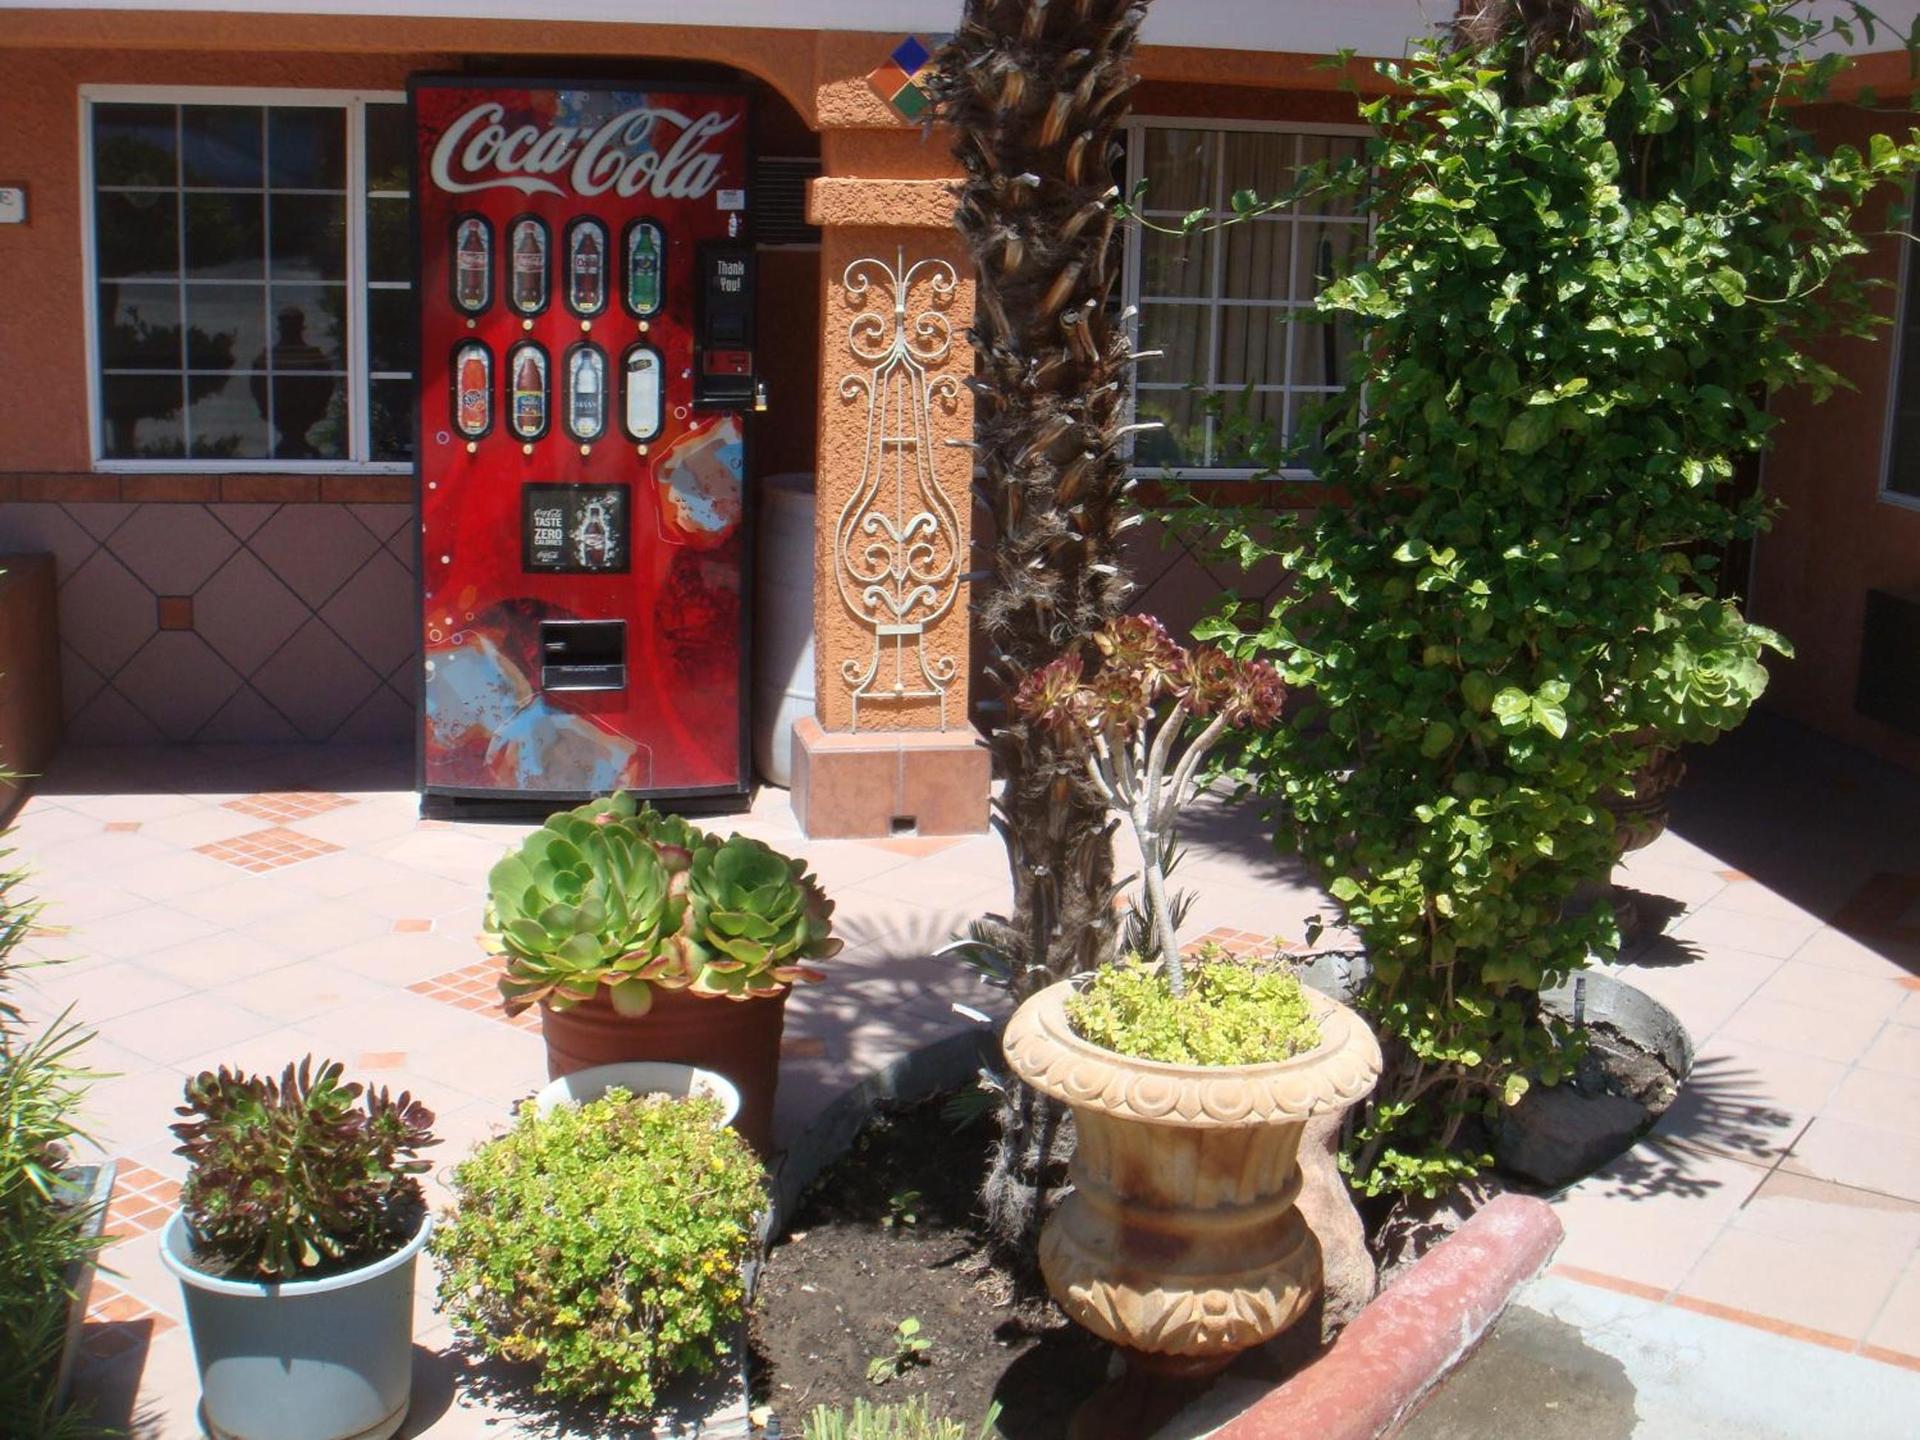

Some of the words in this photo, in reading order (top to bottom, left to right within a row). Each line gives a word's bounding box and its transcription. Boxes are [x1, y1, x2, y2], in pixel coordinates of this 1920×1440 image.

[431, 102, 739, 200] Coca-Cola
[718, 260, 745, 275] Thank
[720, 277, 741, 292] You!
[535, 517, 562, 527] TASTE
[534, 528, 562, 540] ZERO
